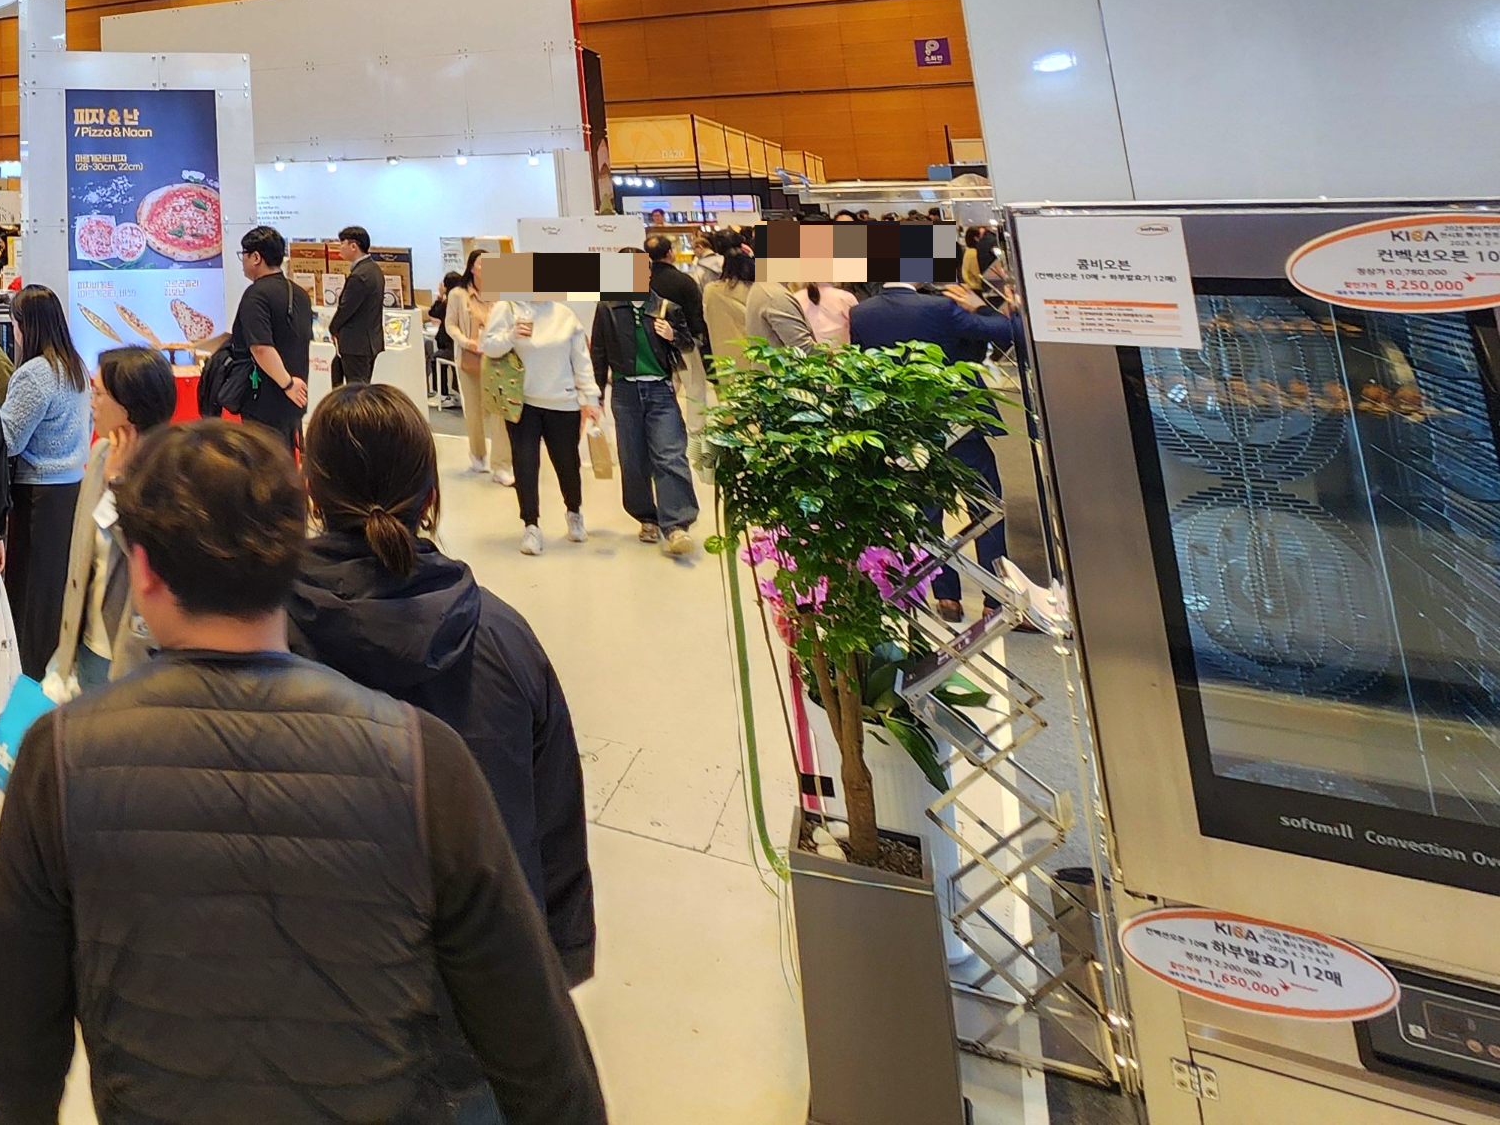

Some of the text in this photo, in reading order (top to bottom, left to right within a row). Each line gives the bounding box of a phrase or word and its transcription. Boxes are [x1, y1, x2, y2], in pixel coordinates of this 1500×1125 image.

[73, 108, 140, 125] 피자 & 난
[122, 126, 153, 137] Naan
[118, 162, 144, 172] 22cm)
[1376, 248, 1500, 264] 컨벡션오븐 10
[1076, 258, 1132, 272] 콤비오븐
[1385, 279, 1465, 293] 8,250,000
[1278, 815, 1354, 841] softmill
[1364, 830, 1468, 863] Convection
[1210, 939, 1298, 976] 하부발효기
[1302, 964, 1344, 989] 12매
[1208, 969, 1280, 997] 1,650,000
